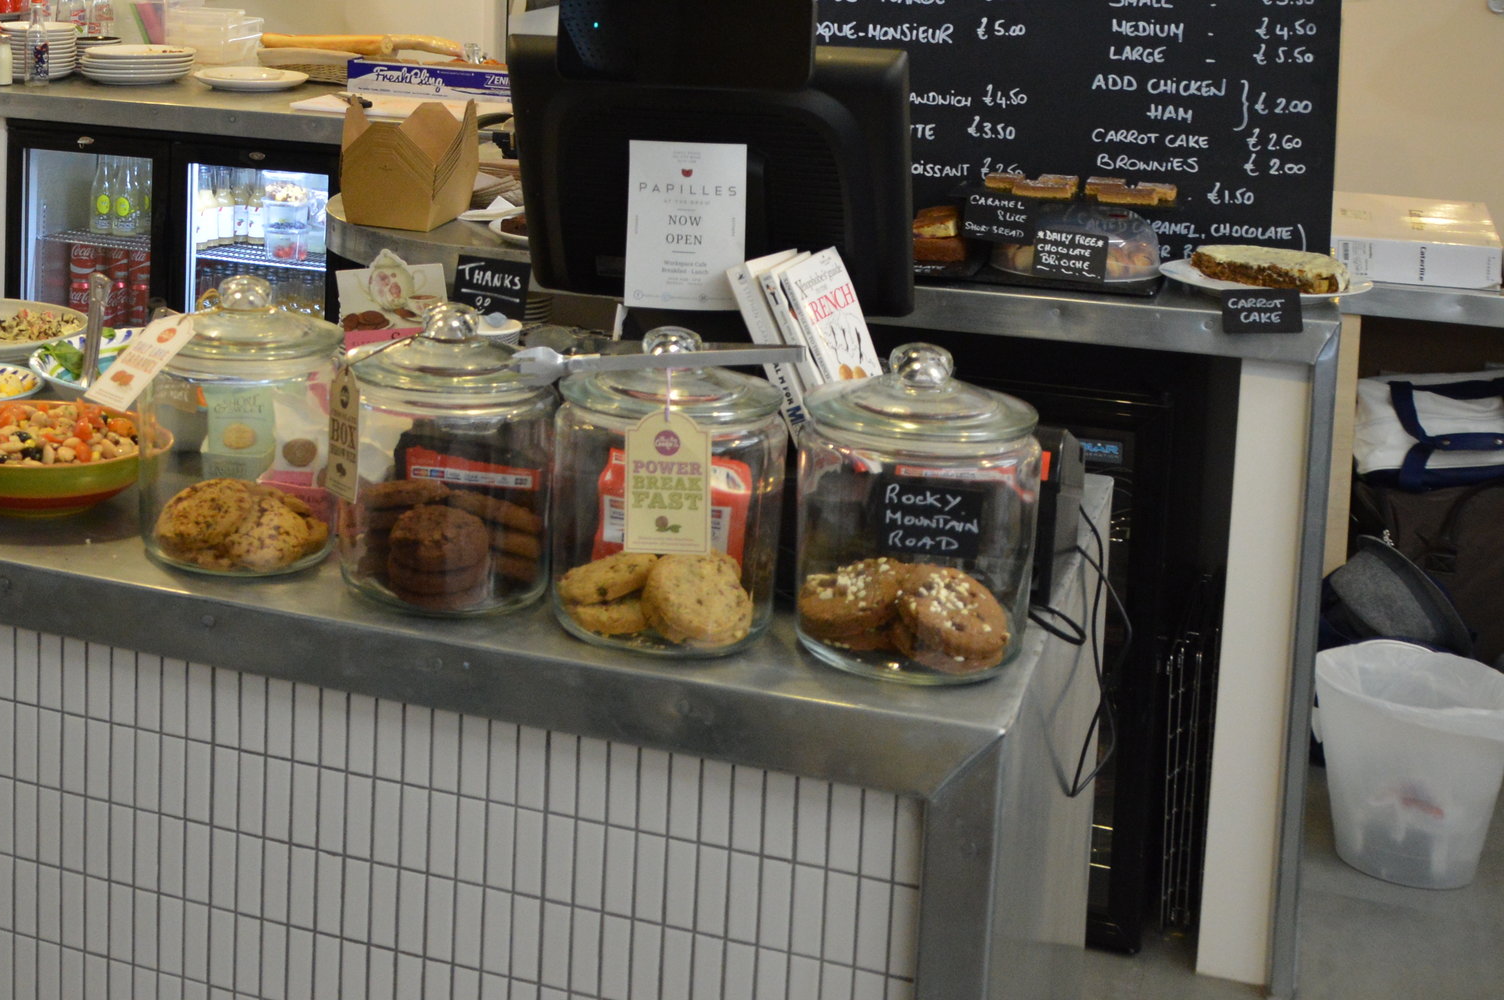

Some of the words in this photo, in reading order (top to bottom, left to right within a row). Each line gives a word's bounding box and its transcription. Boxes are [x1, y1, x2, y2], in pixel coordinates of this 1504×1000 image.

[1111, 19, 1184, 43] MEDIUM
[1109, 45, 1167, 64] LARGE
[1091, 73, 1138, 91] ADD
[1146, 77, 1227, 97] CHICKEN
[1146, 103, 1193, 124] HAM
[1091, 128, 1160, 146] CARROT
[1164, 133, 1210, 149] CAKE
[1097, 153, 1199, 173] BROWNIES
[639, 182, 738, 197] PAPILLES
[969, 194, 1025, 210] CARAMEL
[667, 214, 702, 227] NOW
[996, 209, 1028, 223] SLICE
[665, 233, 703, 246] OPEN
[1036, 243, 1092, 258] CHOCOLATE
[1039, 252, 1091, 270] BRIOCHE
[457, 262, 522, 290] THANKS
[1227, 297, 1286, 309] CARROT
[1240, 311, 1283, 324] CAKE
[331, 418, 357, 451] BOX
[632, 460, 703, 476] POWER
[632, 475, 703, 492] BREAK
[631, 490, 704, 511] FAST
[884, 510, 980, 534] MOUNTAIN
[887, 530, 960, 551] ROAD
